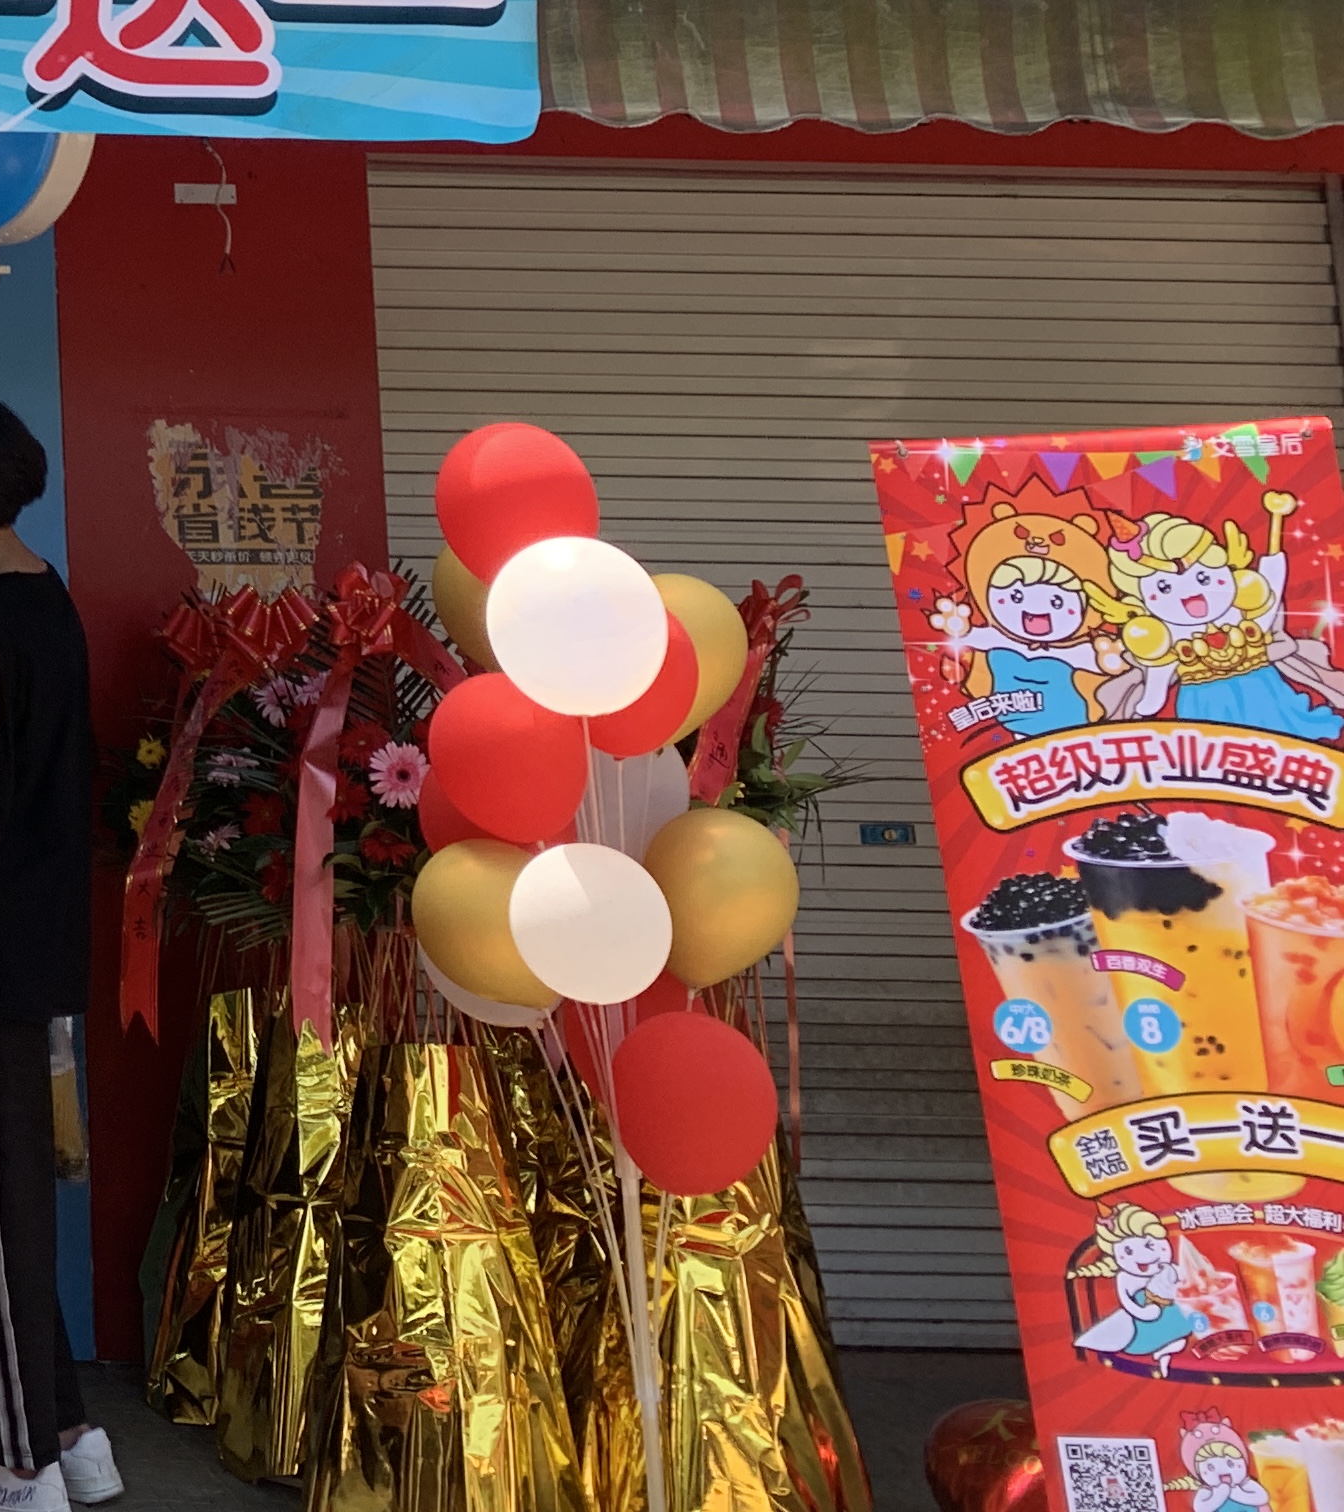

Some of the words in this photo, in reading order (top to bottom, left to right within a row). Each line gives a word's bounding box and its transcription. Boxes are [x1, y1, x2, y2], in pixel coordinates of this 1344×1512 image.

[1204, 433, 1303, 458] 艾雪皇后
[996, 736, 1334, 811] 超级开业盛典
[1105, 955, 1168, 980] 百香双生
[1000, 1015, 1051, 1045] 6/8
[1140, 1015, 1163, 1045] 8
[1075, 1129, 1118, 1157] 全场
[1129, 1104, 1344, 1166] 买一送一
[1085, 1151, 1130, 1180] 饮品
[1176, 1202, 1255, 1230] 冰雪盛会
